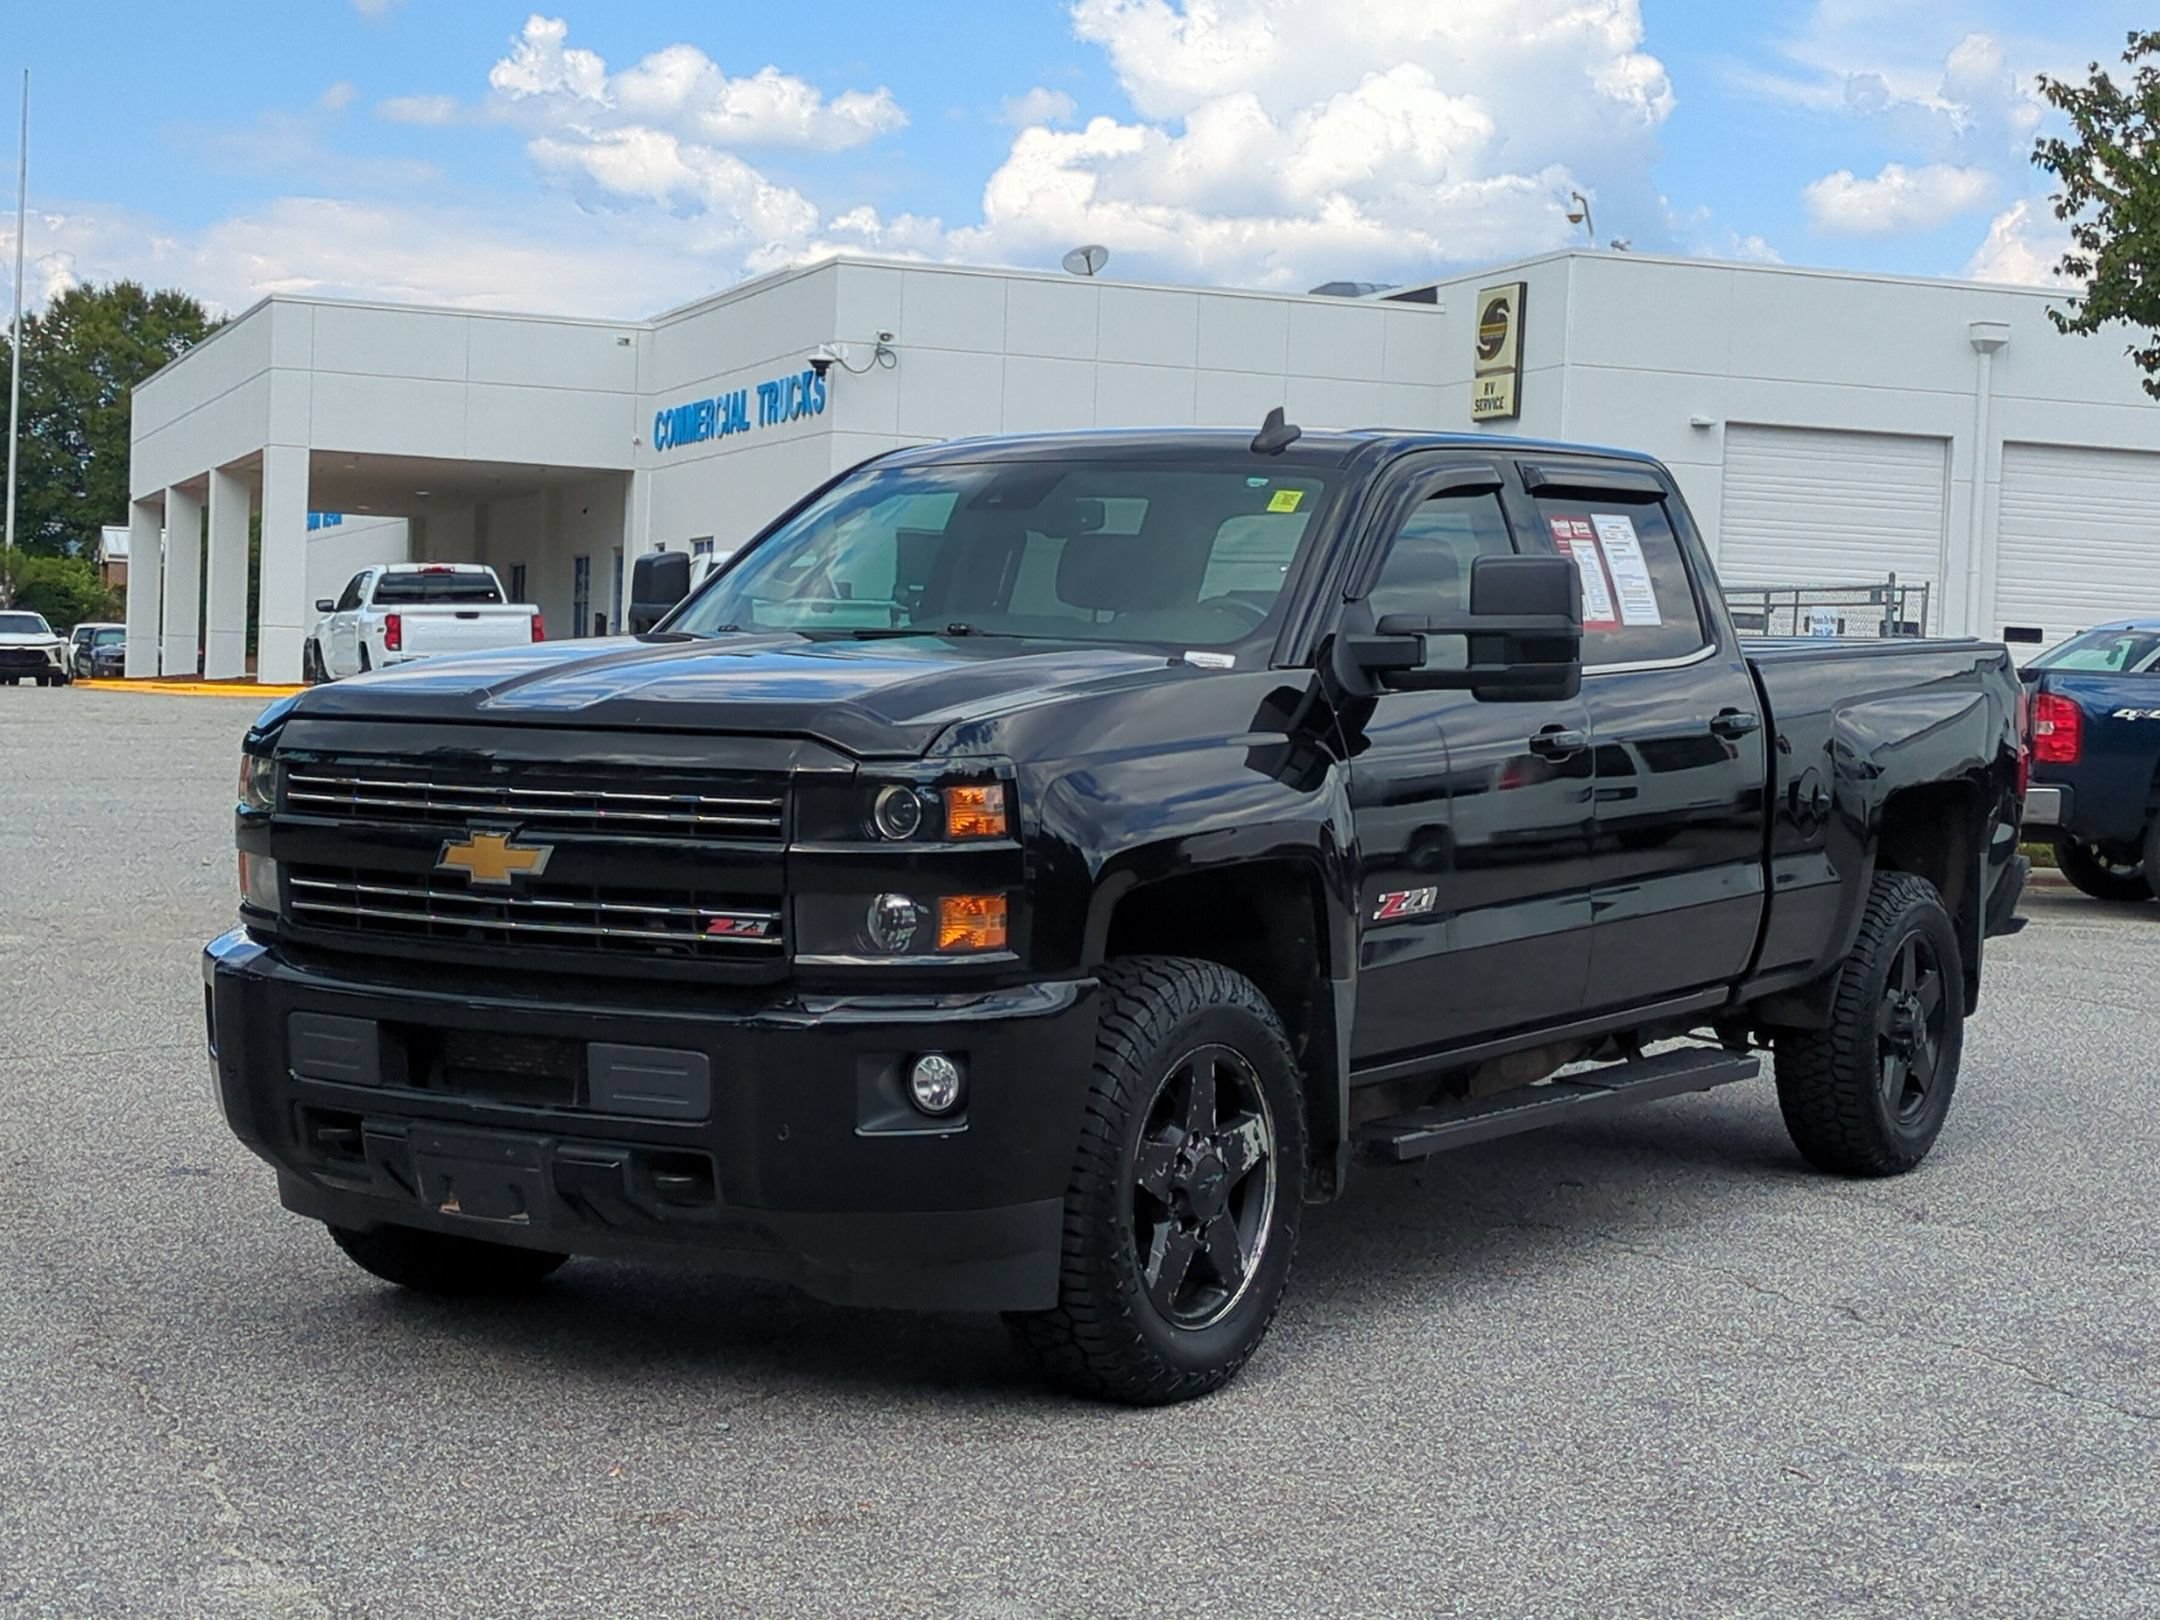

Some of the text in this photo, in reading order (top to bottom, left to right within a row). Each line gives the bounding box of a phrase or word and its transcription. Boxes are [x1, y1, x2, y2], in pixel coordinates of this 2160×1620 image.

[1484, 382, 1496, 396] RV
[654, 370, 827, 452] COMMERCIAL TRUCKS
[1474, 396, 1505, 413] SERVICE
[1372, 886, 1438, 920] Z71
[705, 918, 769, 936] Z71
